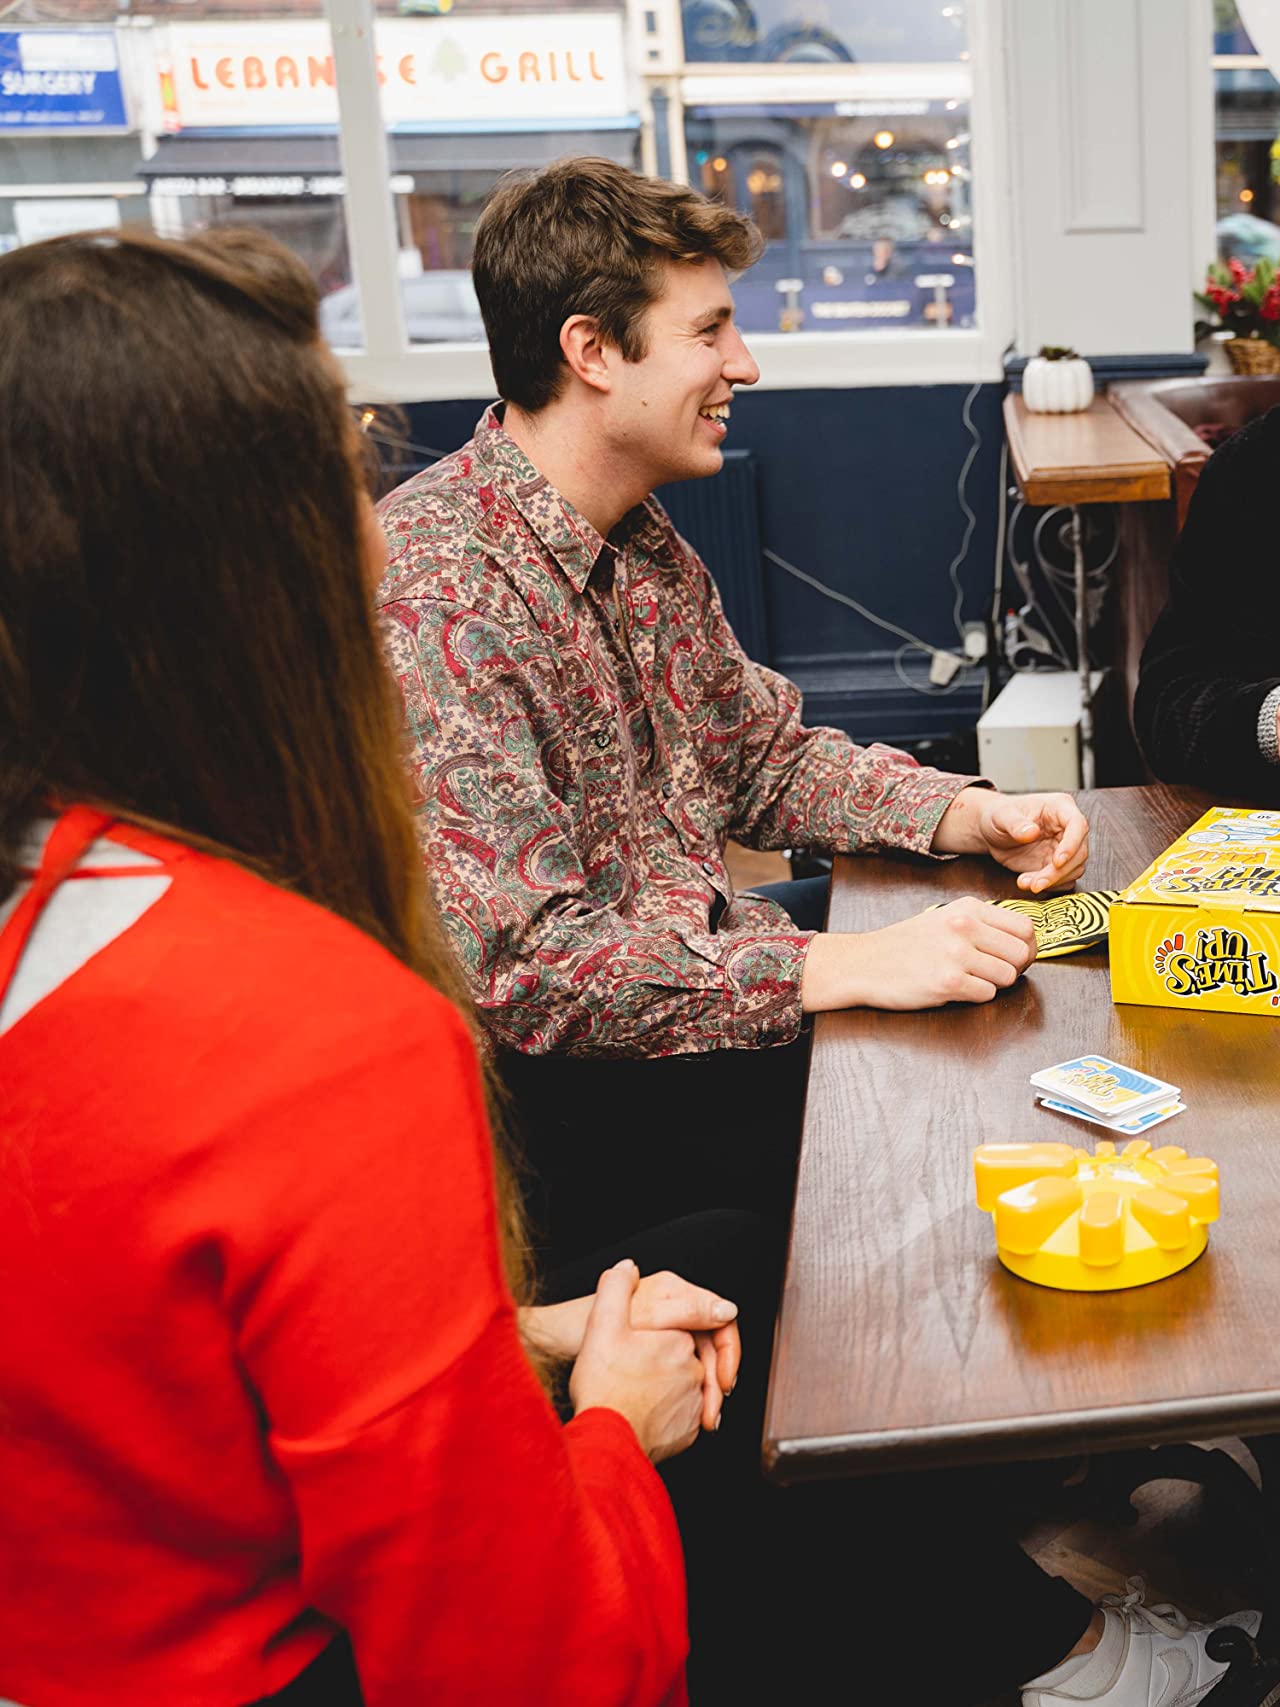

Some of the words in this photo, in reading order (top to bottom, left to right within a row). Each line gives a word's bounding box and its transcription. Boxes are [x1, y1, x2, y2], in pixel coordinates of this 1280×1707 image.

[1, 70, 97, 96] SURGERY
[191, 54, 417, 90] LEBANE
[480, 51, 604, 84] GRILL
[1175, 850, 1269, 865] PARTY
[1196, 928, 1248, 962] UP!
